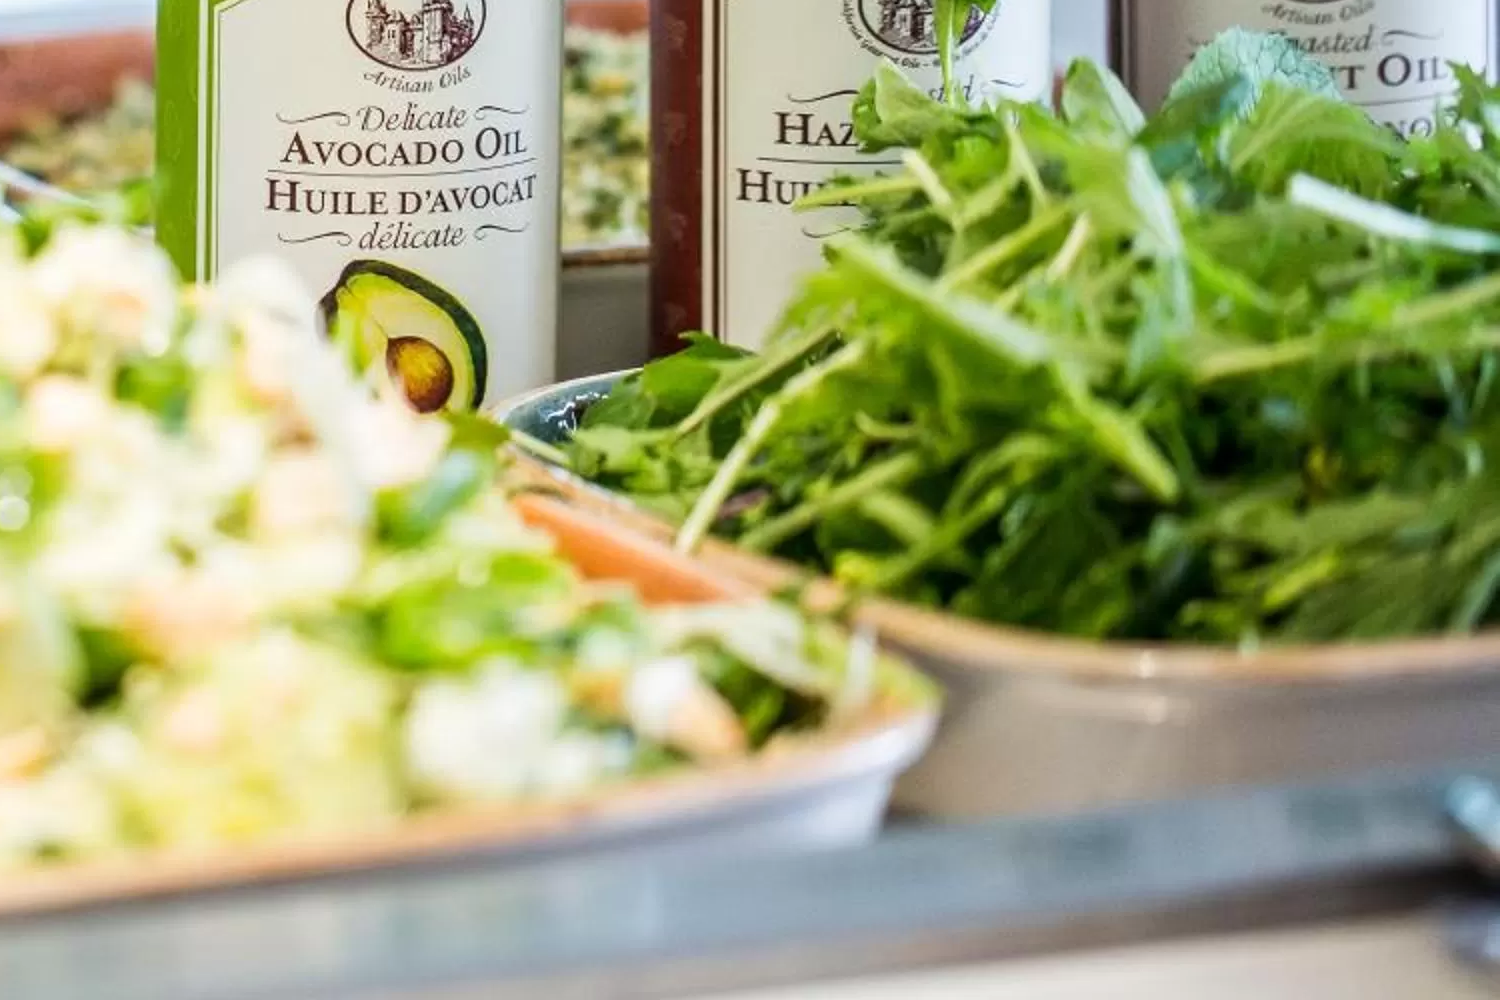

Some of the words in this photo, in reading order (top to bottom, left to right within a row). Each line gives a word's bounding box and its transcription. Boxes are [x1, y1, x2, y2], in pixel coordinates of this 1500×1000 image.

[1261, 3, 1333, 25] Artisan
[1267, 23, 1374, 53] asted
[363, 70, 434, 93] Artisan
[439, 66, 473, 88] Oils
[1377, 53, 1448, 88] OIL
[356, 102, 469, 132] Delicate
[280, 131, 464, 167] AVOCADO
[474, 127, 527, 161] OIL
[264, 177, 388, 216] HUILE
[399, 173, 538, 216] D'AVOCAT
[358, 220, 467, 252] délicate
